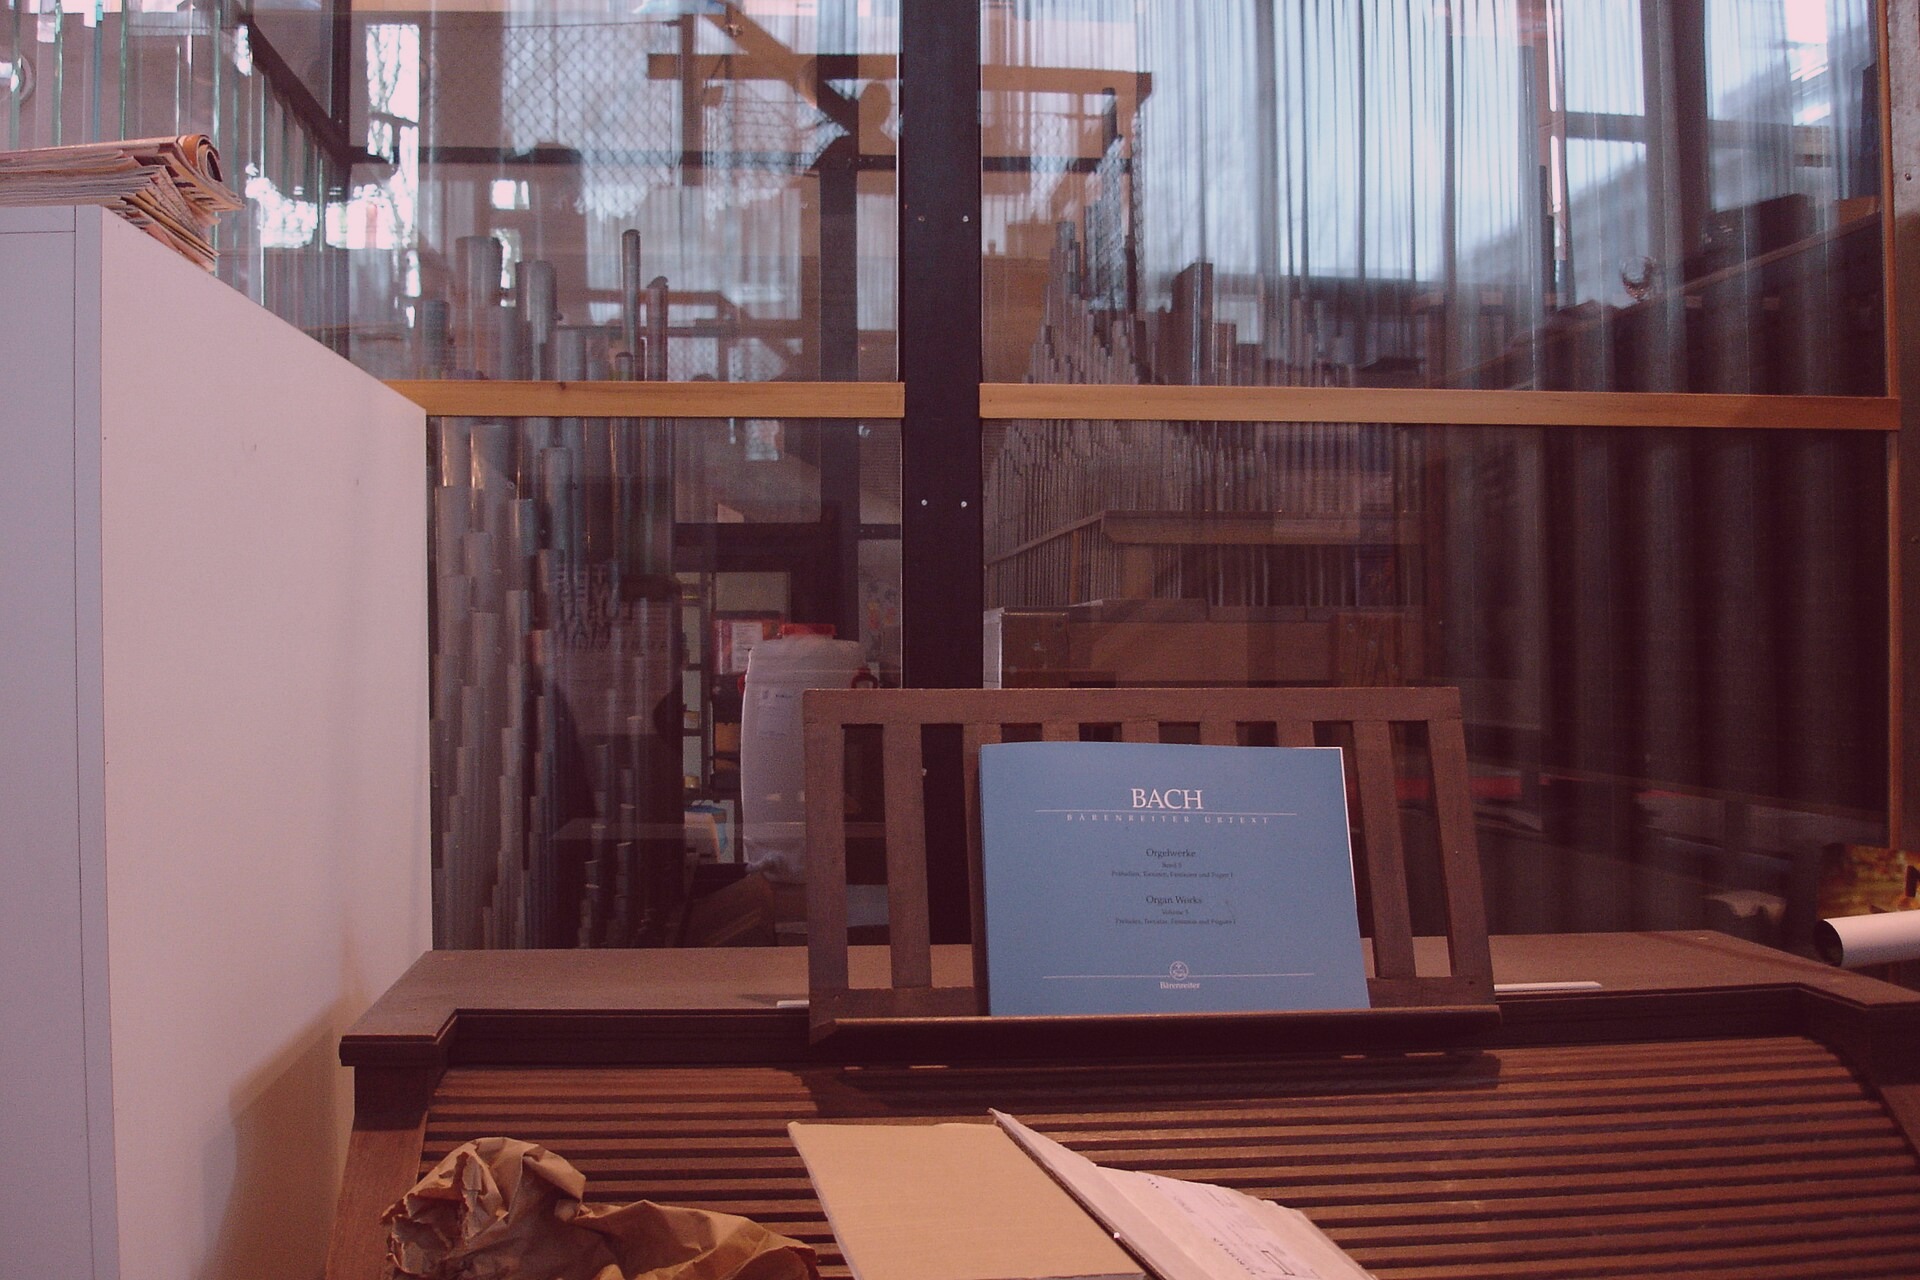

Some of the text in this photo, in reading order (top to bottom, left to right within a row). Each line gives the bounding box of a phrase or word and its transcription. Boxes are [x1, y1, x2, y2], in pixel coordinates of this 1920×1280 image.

[1131, 788, 1204, 810] BACH
[1204, 816, 1269, 824] URTEXT
[1145, 848, 1196, 859] Orgelwerke
[1145, 895, 1202, 905] Organ Works
